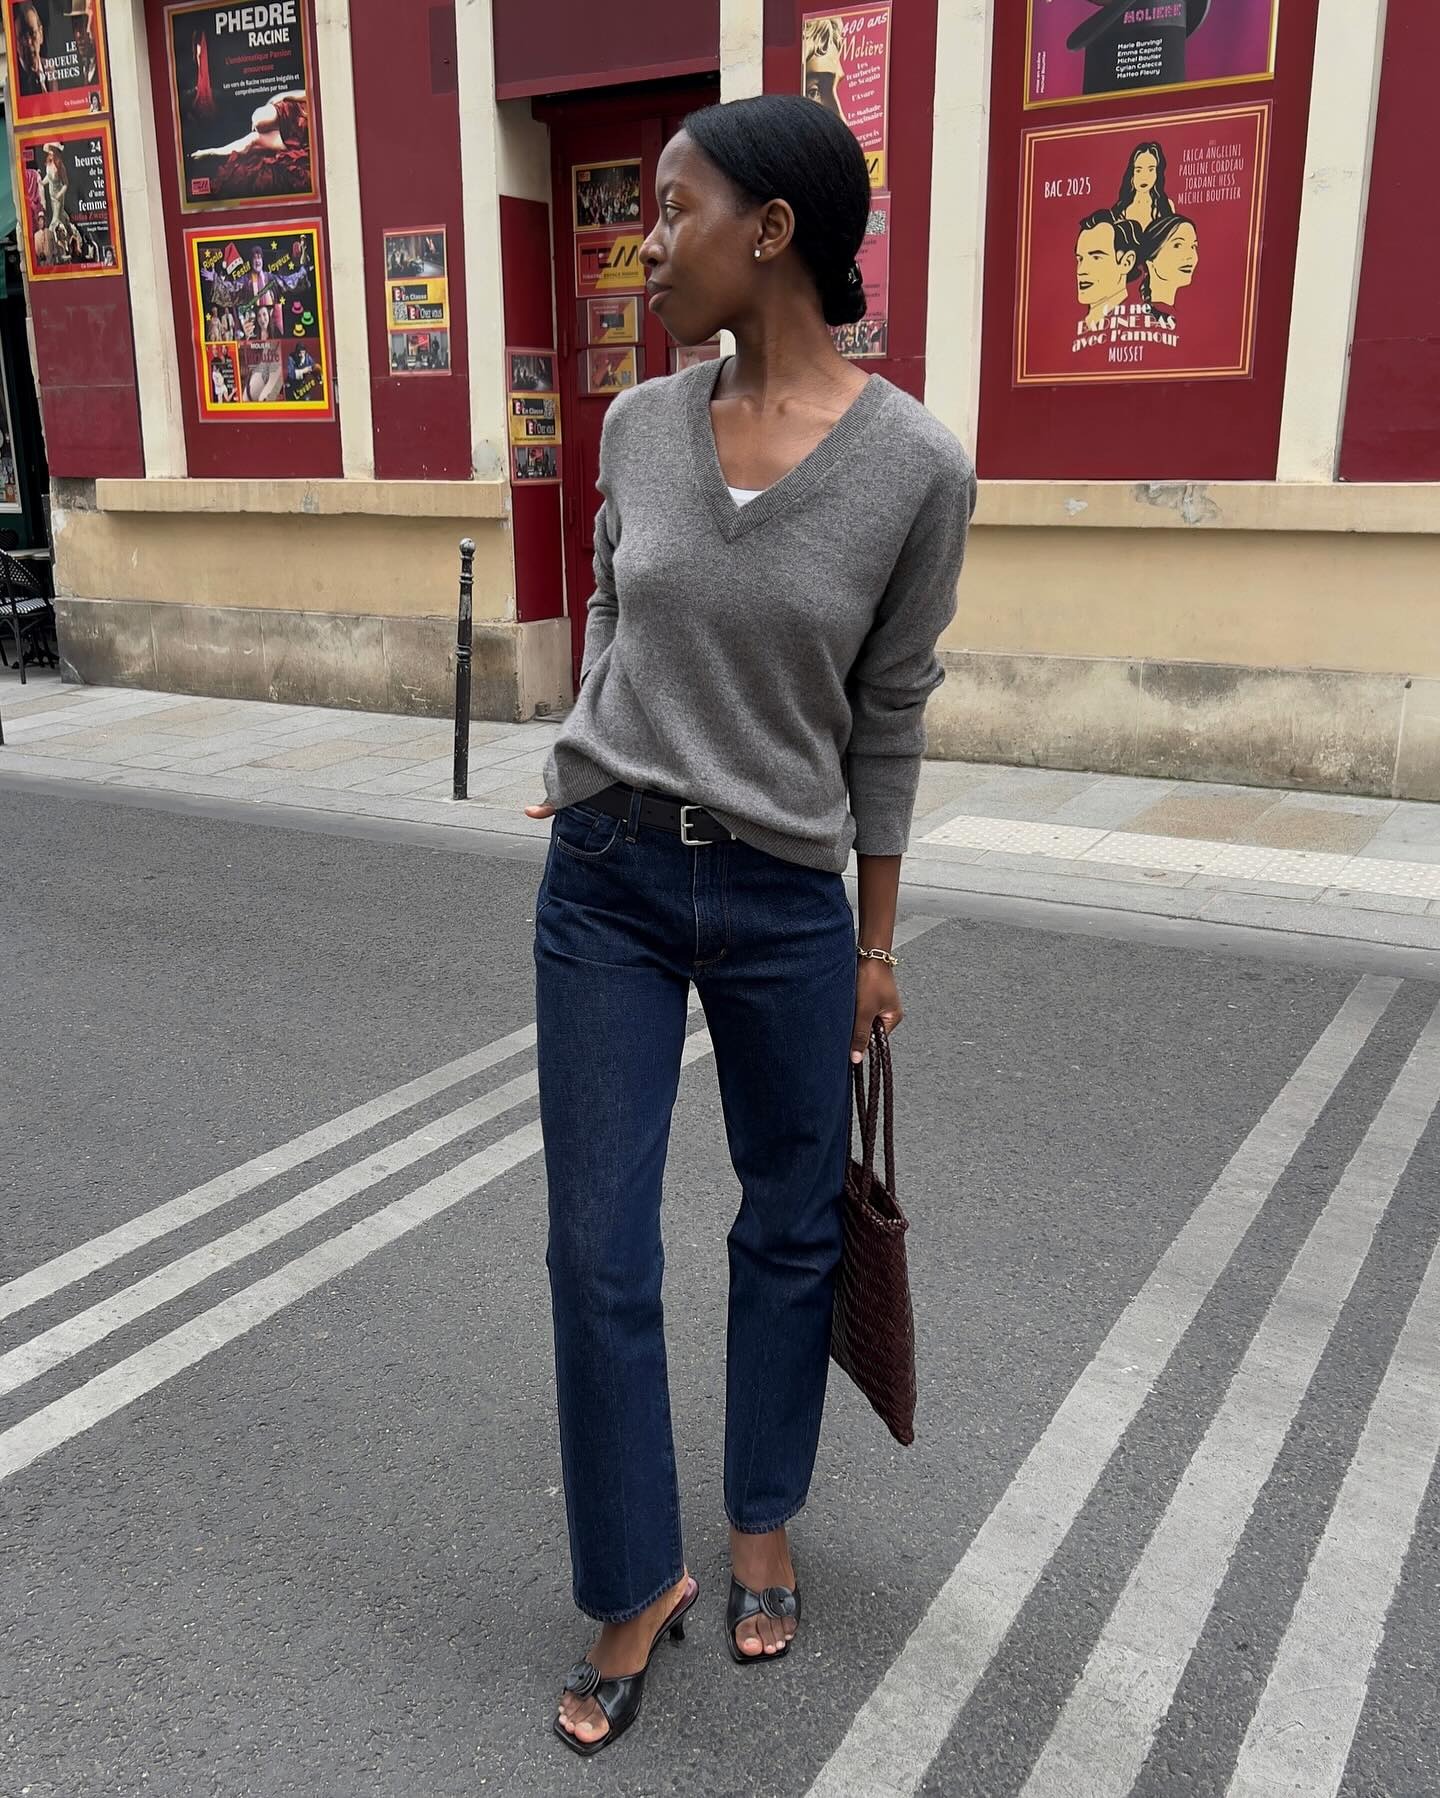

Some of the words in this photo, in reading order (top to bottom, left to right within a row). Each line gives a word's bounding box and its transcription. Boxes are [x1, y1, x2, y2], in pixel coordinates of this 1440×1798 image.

[215, 0, 296, 34] PHEDRE
[842, 18, 864, 36] 400
[867, 12, 888, 28] ans
[248, 28, 290, 48] RACINE
[65, 41, 78, 52] LE
[840, 35, 884, 61] Molière
[1139, 46, 1162, 54] Caputo
[44, 54, 78, 68] JOUEUR
[1118, 56, 1138, 64] Michel
[1117, 71, 1138, 79] Matteo
[90, 141, 102, 153] 24
[1183, 148, 1204, 162] ERICA
[1206, 144, 1241, 159] ANGELINI
[74, 155, 103, 167] heures
[1179, 162, 1208, 176] PAULINE
[1211, 158, 1244, 173] CORDEAU
[89, 168, 96, 176] de
[93, 176, 104, 188] vie
[1044, 180, 1063, 199] BAC
[1066, 177, 1091, 196] 2025
[1185, 175, 1216, 191] JORDANE
[1219, 173, 1235, 187] HESS
[1178, 191, 1203, 205] MICHEL
[1206, 187, 1241, 202] BOUTTIER
[79, 200, 107, 211] femme
[1130, 303, 1152, 315] ne
[1144, 315, 1176, 330] PAS
[1072, 333, 1107, 353] avec
[1110, 329, 1179, 347] l'amour
[1108, 346, 1144, 362] MUSSET
